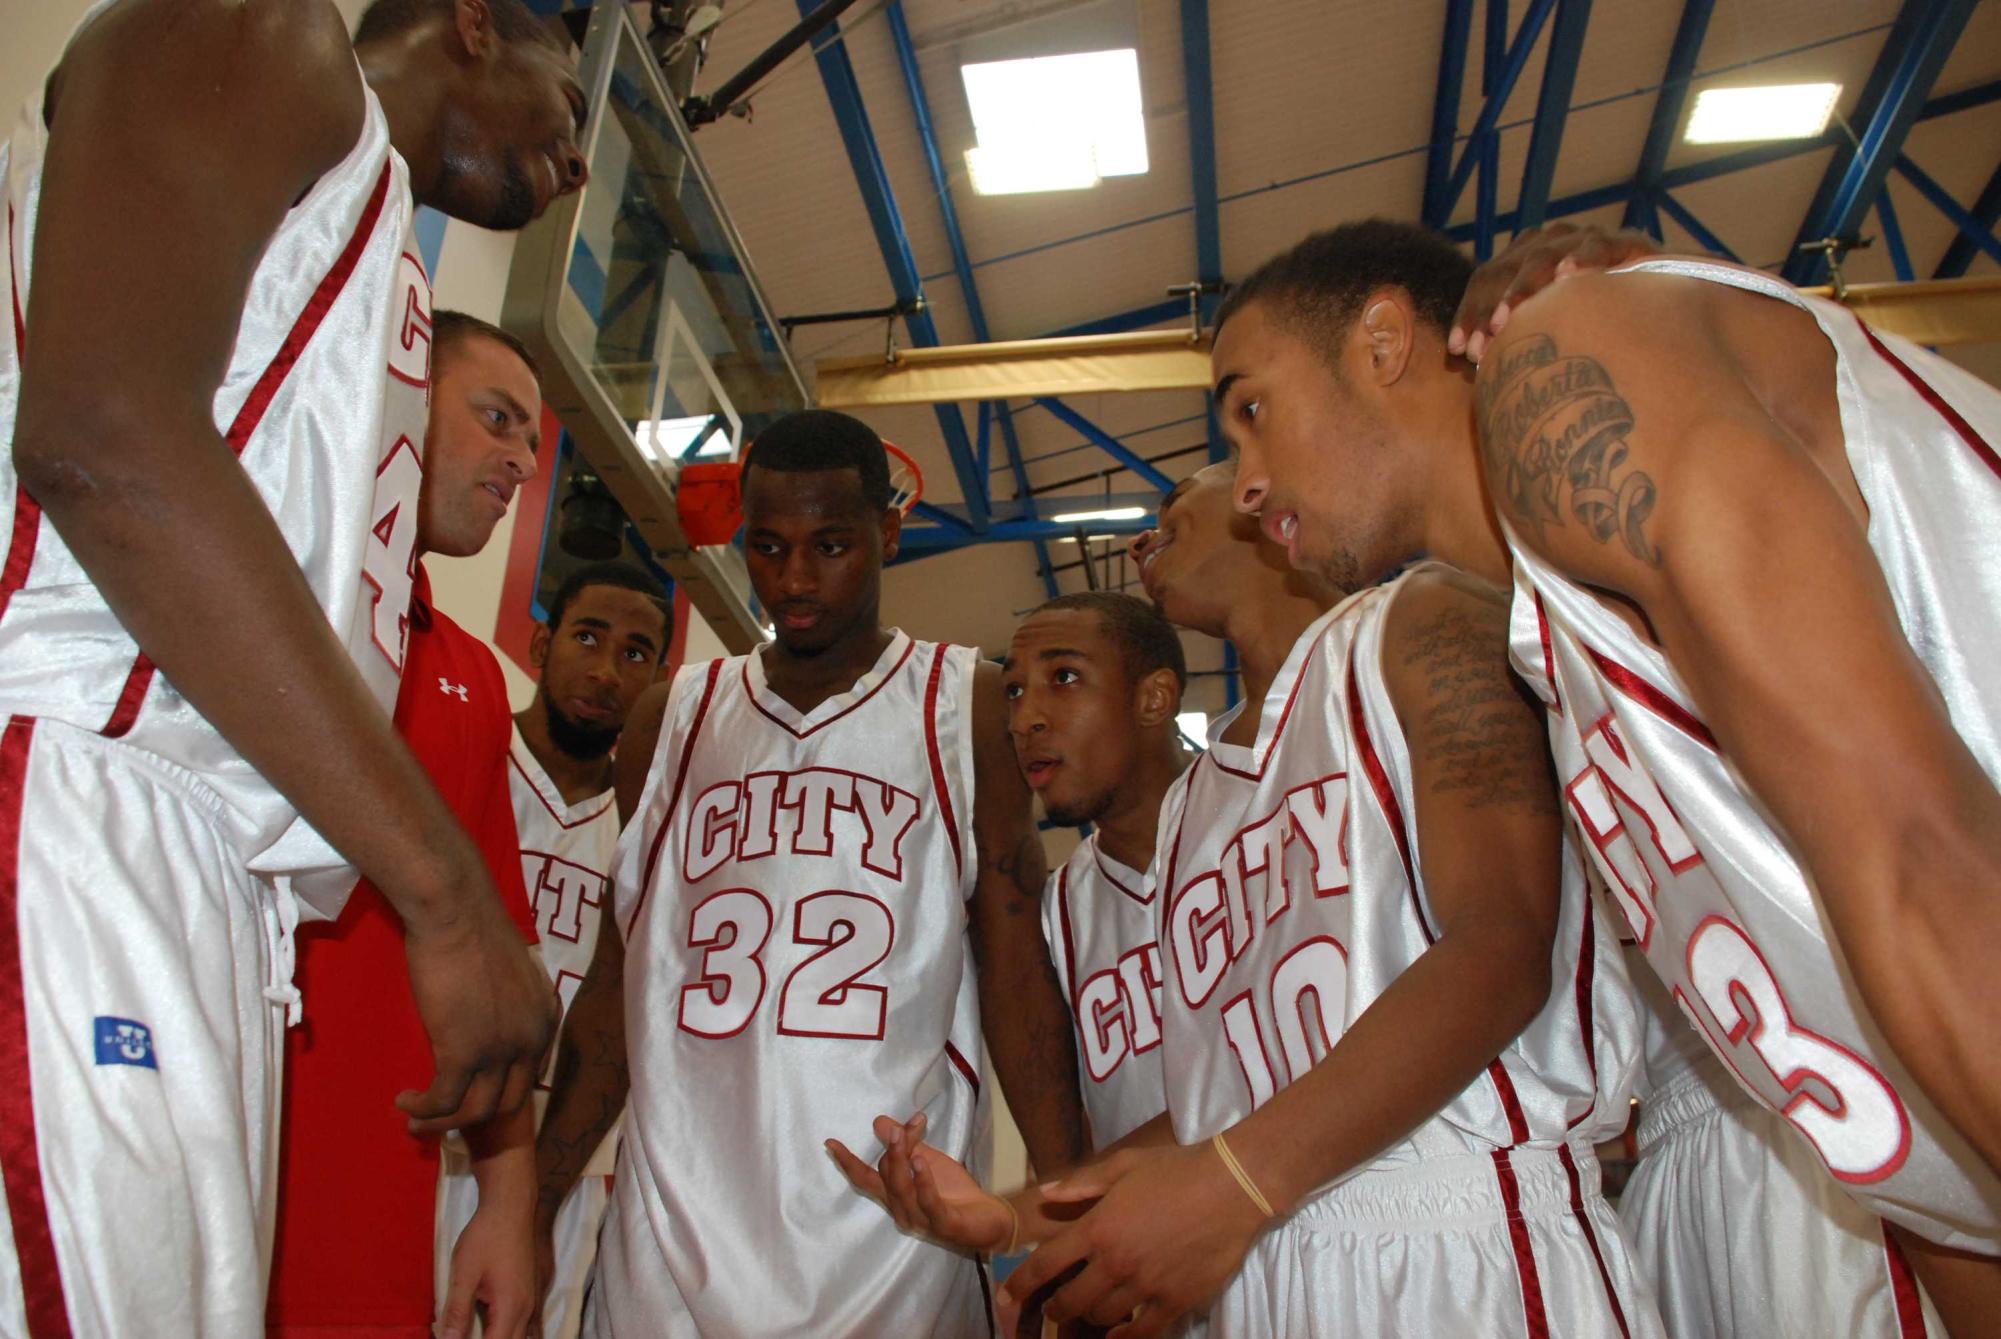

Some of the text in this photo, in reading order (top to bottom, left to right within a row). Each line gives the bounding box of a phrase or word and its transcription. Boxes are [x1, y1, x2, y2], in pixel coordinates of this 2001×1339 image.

[683, 766, 920, 884] CITY
[1170, 772, 1349, 1010] CITY
[677, 888, 895, 1041] 32
[1077, 941, 1163, 1084] CI
[1220, 934, 1349, 1112] 10
[1673, 914, 1913, 1186] 3
